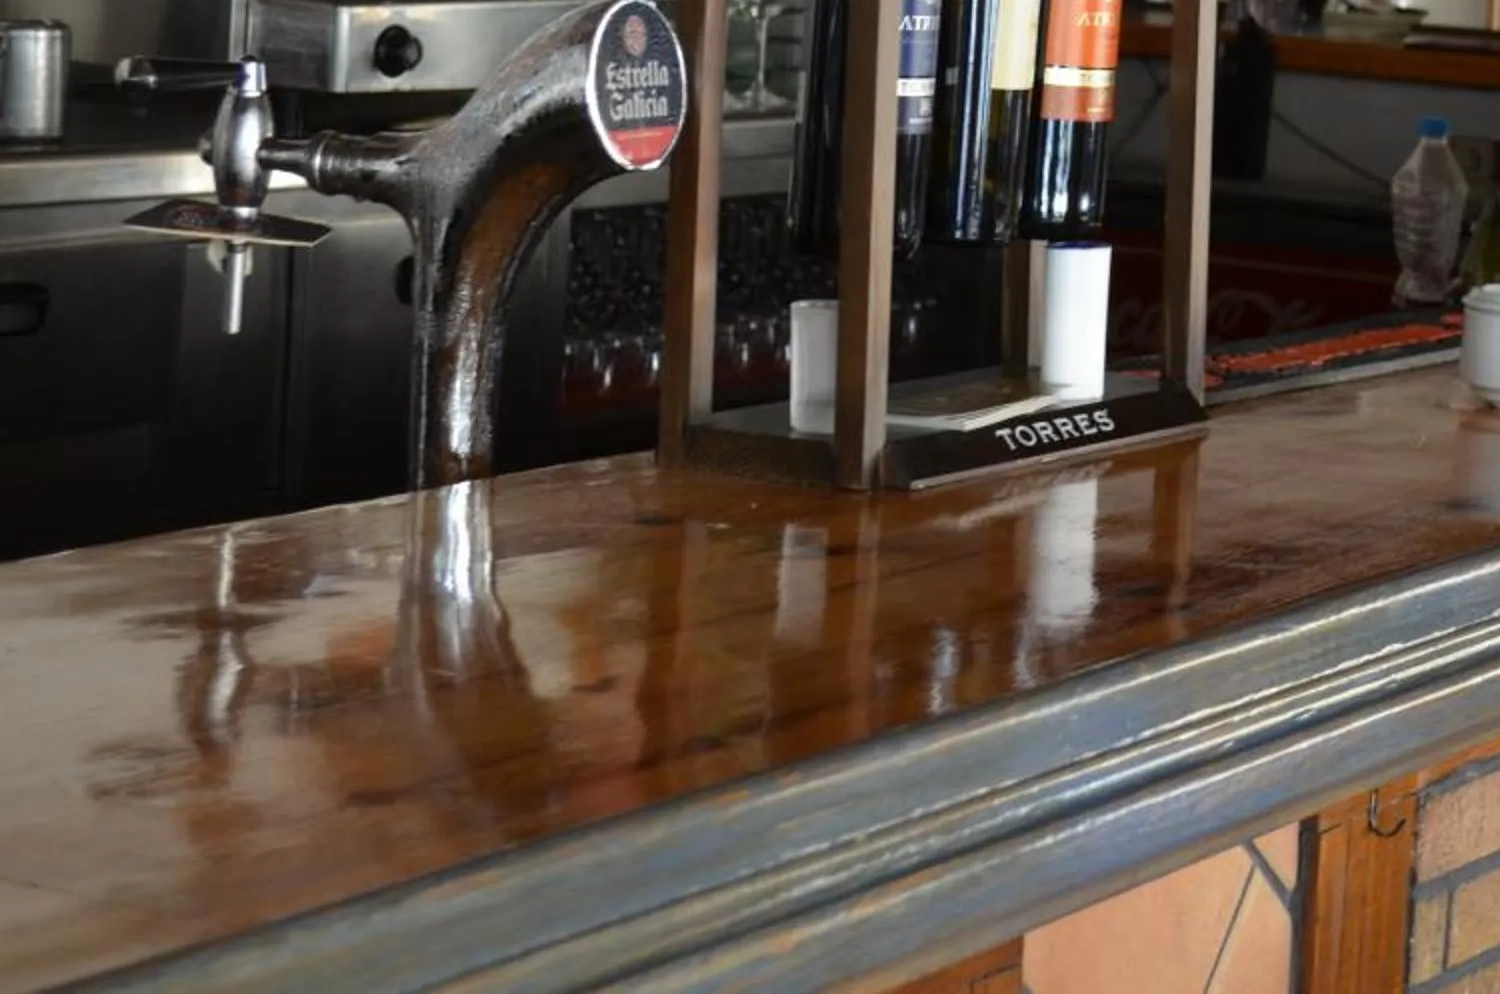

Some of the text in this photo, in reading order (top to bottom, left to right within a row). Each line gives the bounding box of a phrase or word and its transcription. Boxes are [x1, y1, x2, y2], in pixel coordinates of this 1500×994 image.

[605, 60, 669, 90] Estrella
[609, 89, 669, 121] Galicia
[995, 408, 1115, 451] TORRES
